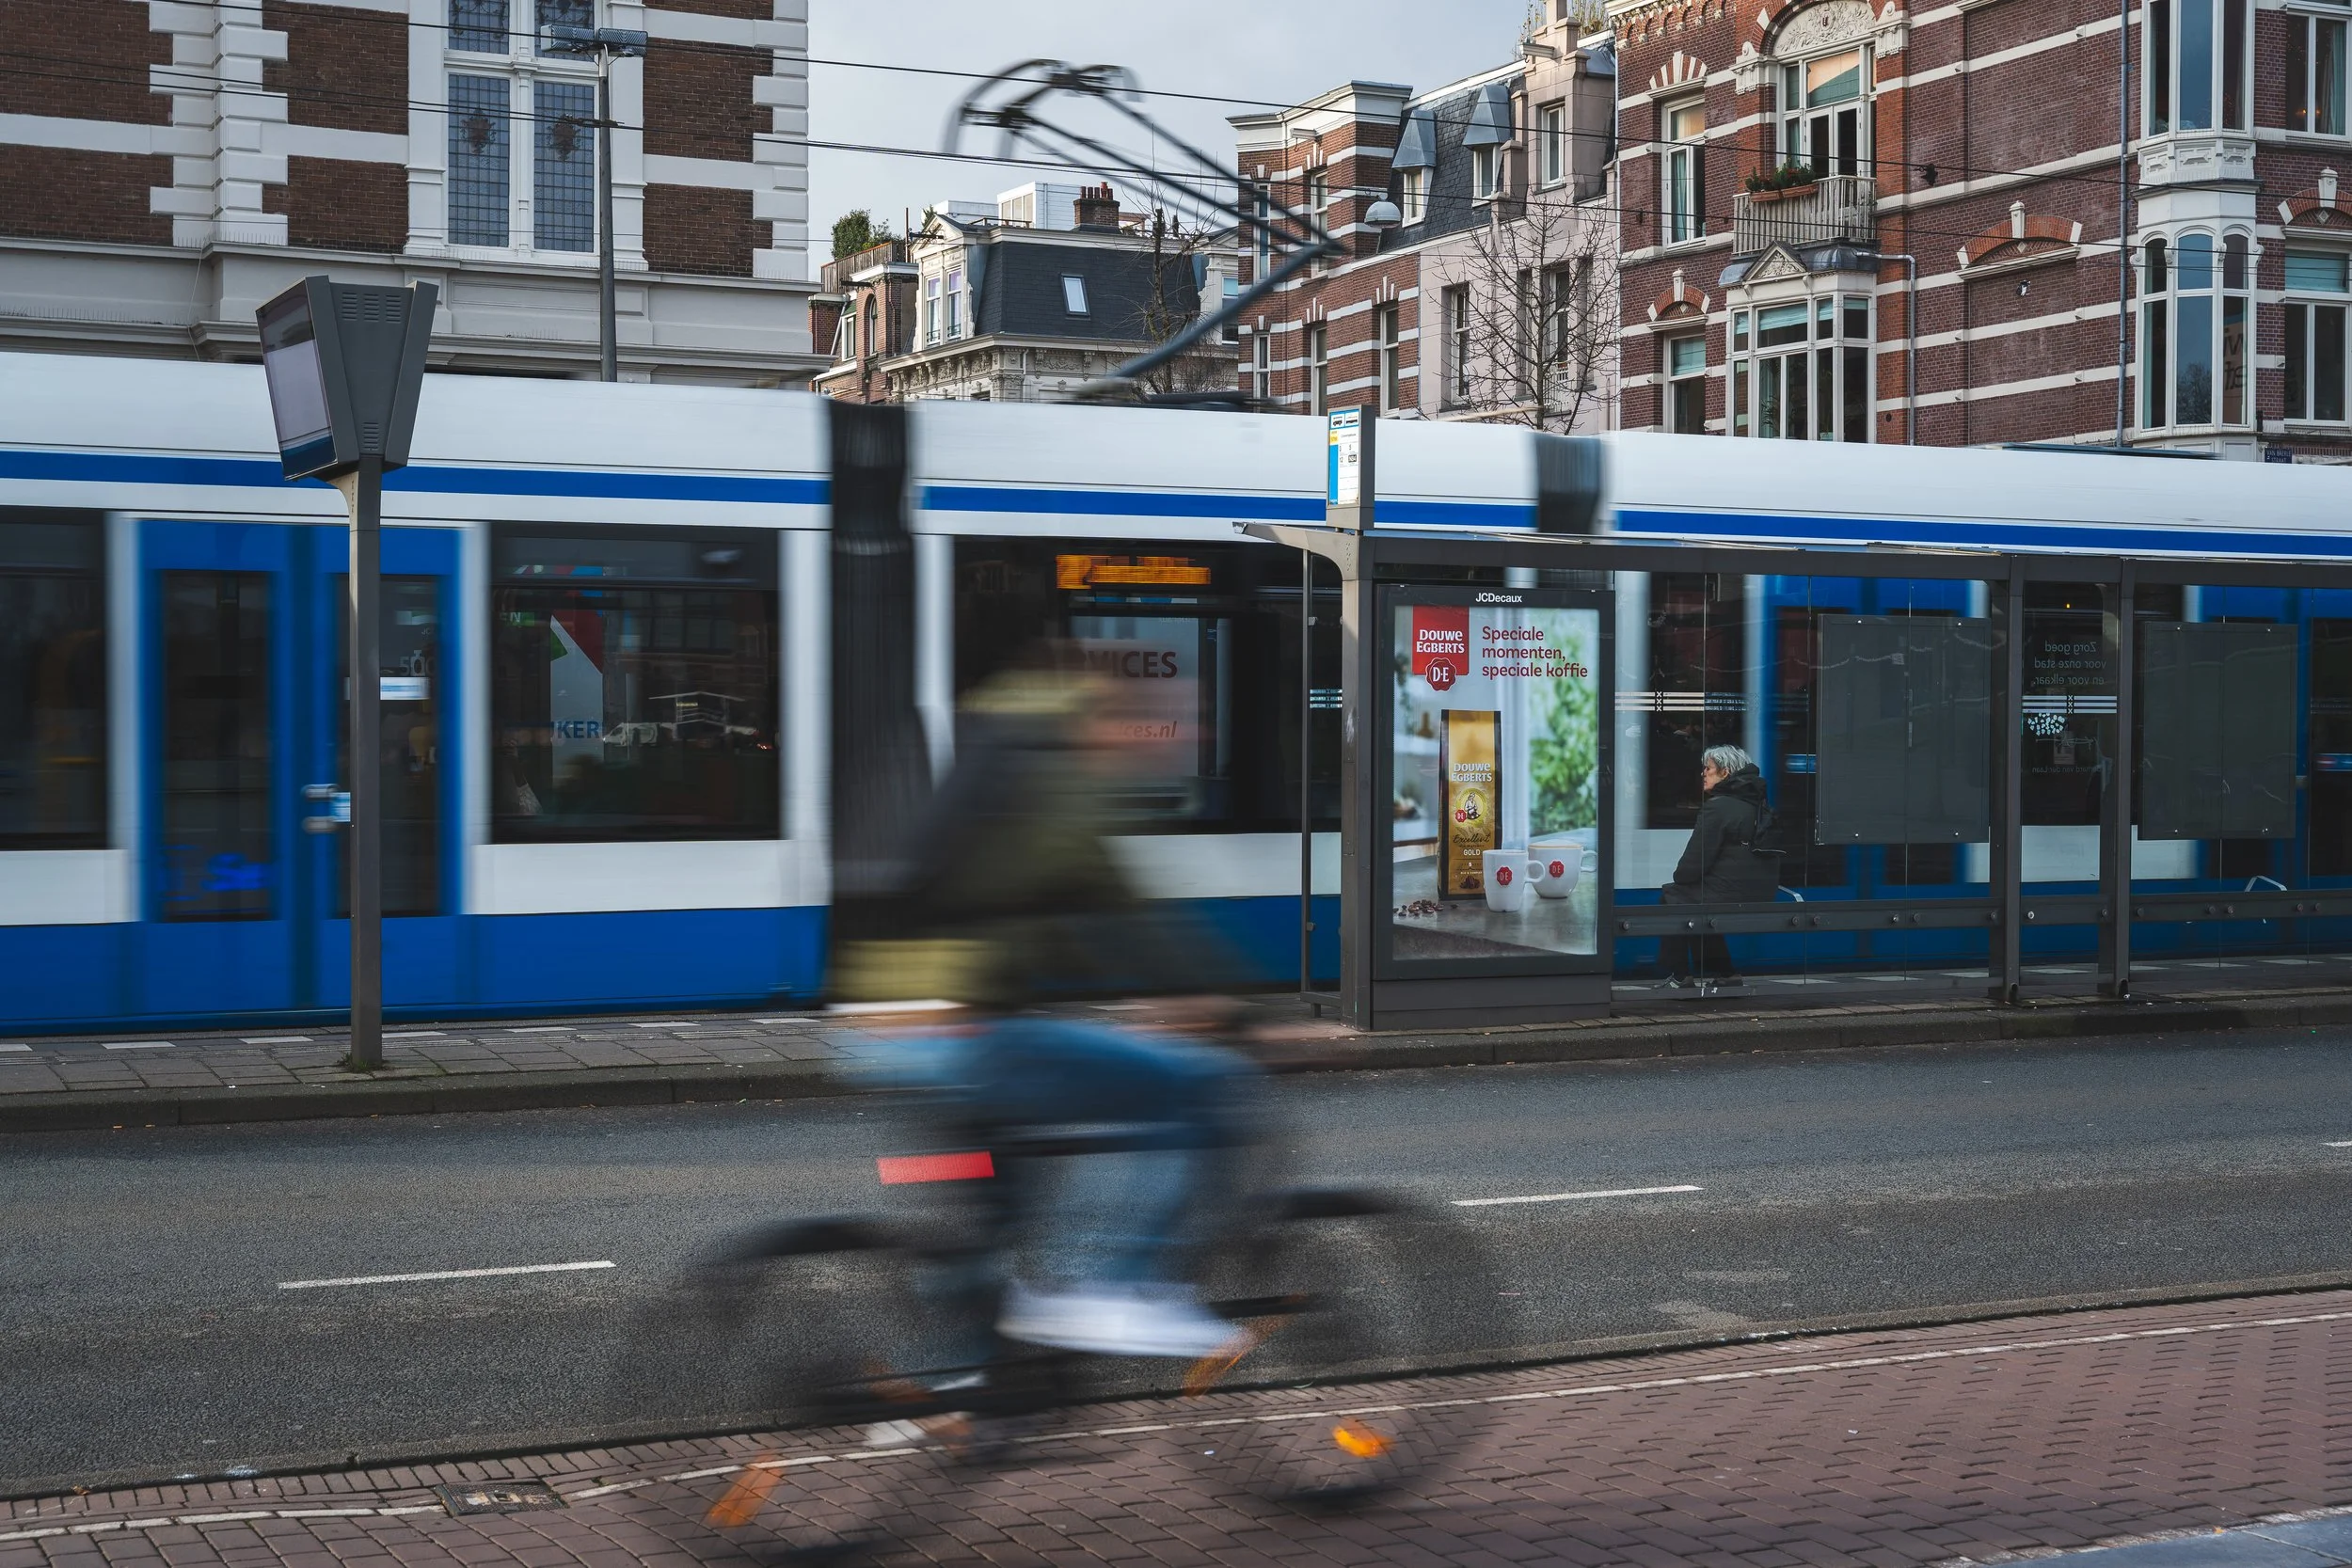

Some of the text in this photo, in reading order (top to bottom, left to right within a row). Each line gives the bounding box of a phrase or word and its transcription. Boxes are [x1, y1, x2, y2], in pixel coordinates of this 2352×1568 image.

[1475, 593, 1522, 603] JCDecaux
[1419, 629, 1463, 641] DOUWE
[1482, 626, 1544, 643] Speciale
[1416, 641, 1465, 654] EGBERTS
[1482, 645, 1565, 661] momenten,
[1482, 662, 1588, 680] speciale koffie
[1454, 763, 1491, 772] DOUWE
[1451, 772, 1493, 783] EGBERTS
[1453, 832, 1491, 844] Excellent
